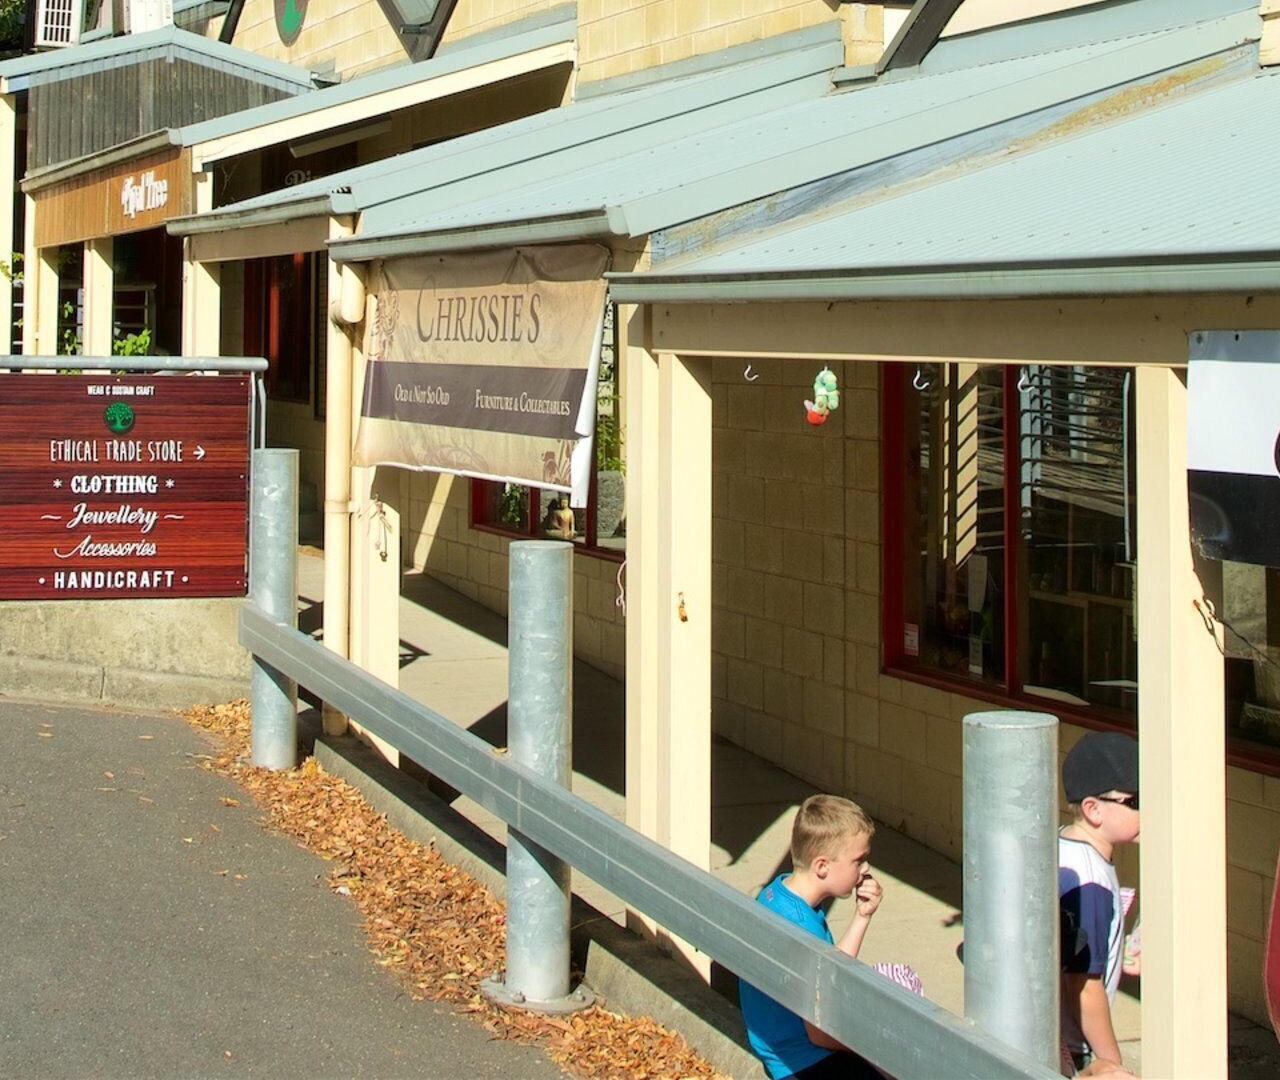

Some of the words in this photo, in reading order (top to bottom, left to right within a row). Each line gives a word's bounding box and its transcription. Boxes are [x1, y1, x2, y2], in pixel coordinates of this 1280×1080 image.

[50, 439, 99, 462] ETHICAL
[106, 439, 142, 462] TRADE
[148, 440, 183, 462] STORE
[71, 475, 158, 493] CLOTHING
[66, 503, 158, 534] Jewellery
[53, 534, 157, 559] Accessories
[54, 571, 175, 588] HANDICRAFT
